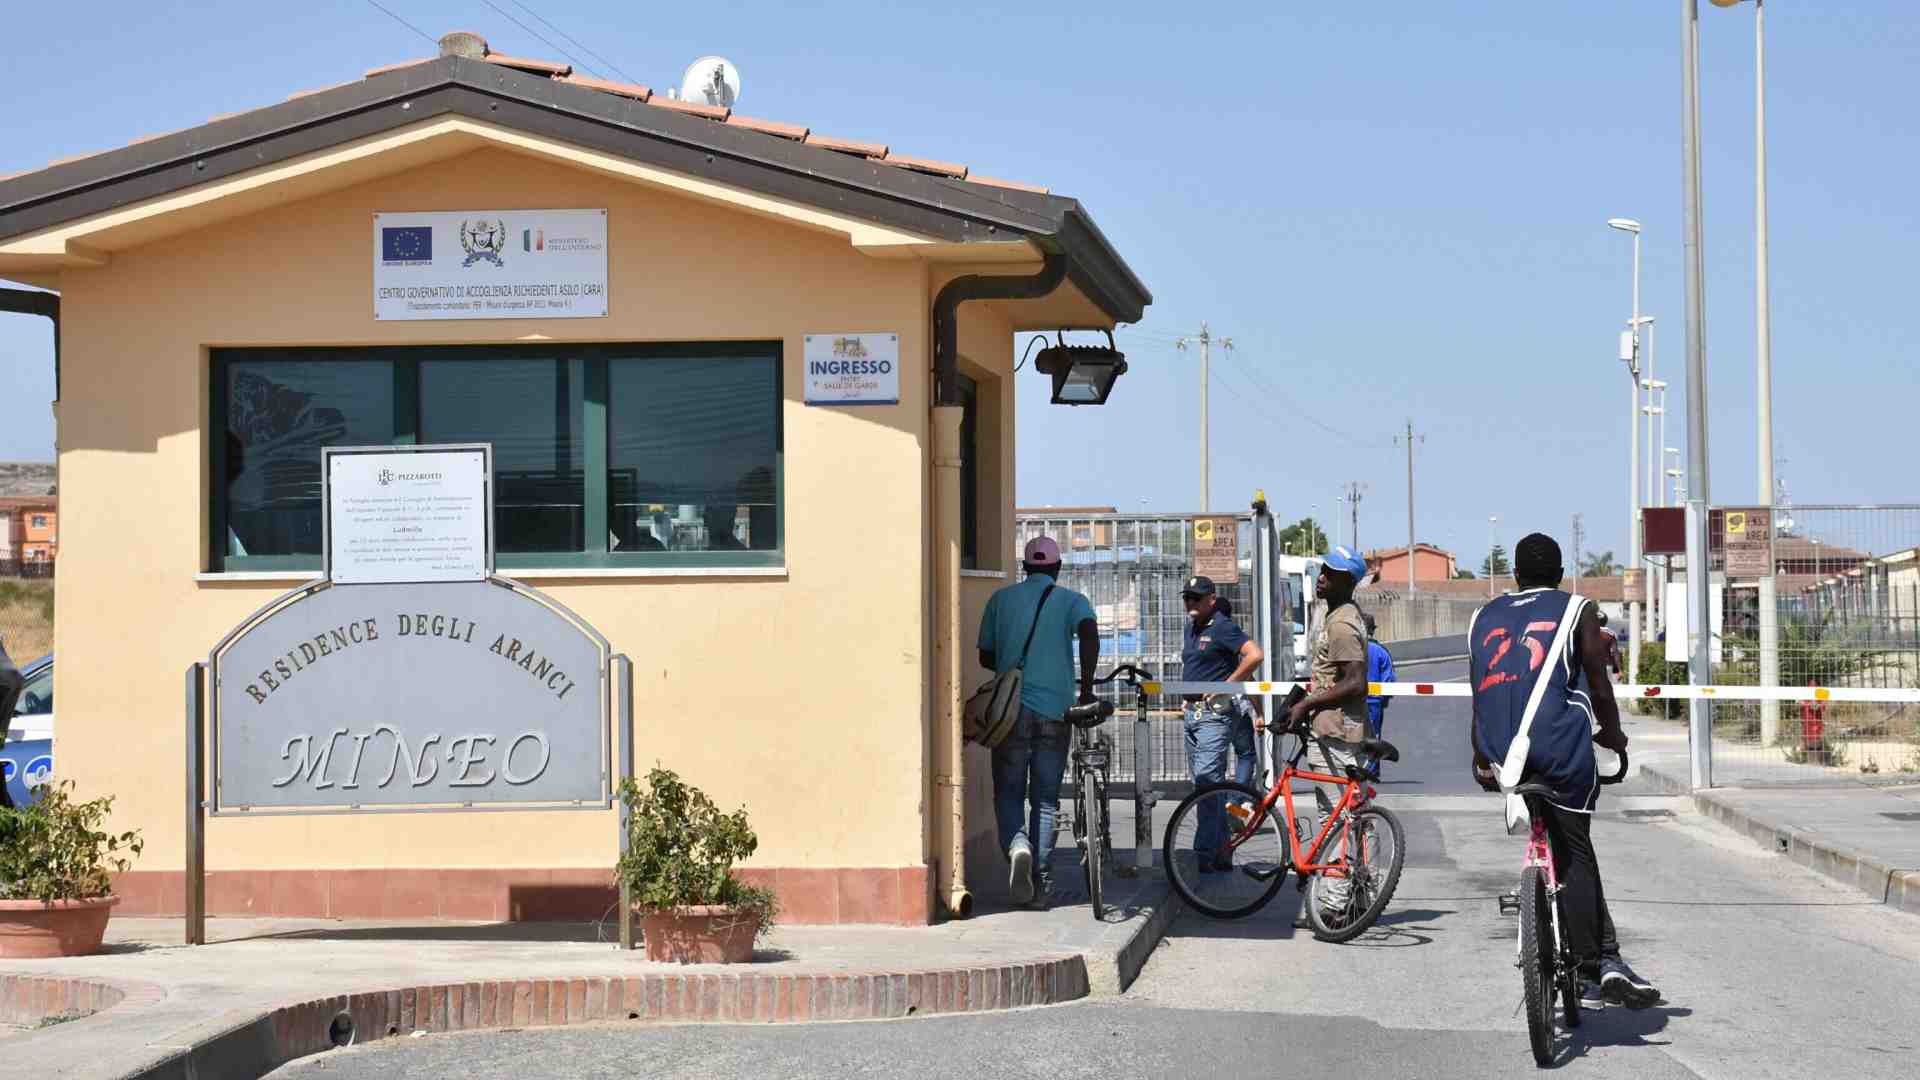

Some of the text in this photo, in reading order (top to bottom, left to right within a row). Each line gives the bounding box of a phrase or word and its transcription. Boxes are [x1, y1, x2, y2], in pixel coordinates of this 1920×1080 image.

[379, 283, 604, 299] CENTRO GOVERNATIVO DI ACCOGLIENZA RICHIEDENTI ASILO (CARA)
[810, 360, 892, 375] INGRESSO
[398, 472, 442, 481] PIZZAROTTI
[245, 613, 576, 704] RESIDENCE DEGLI ARANCI
[1478, 621, 1558, 692] 25
[272, 722, 552, 790] MINEO
